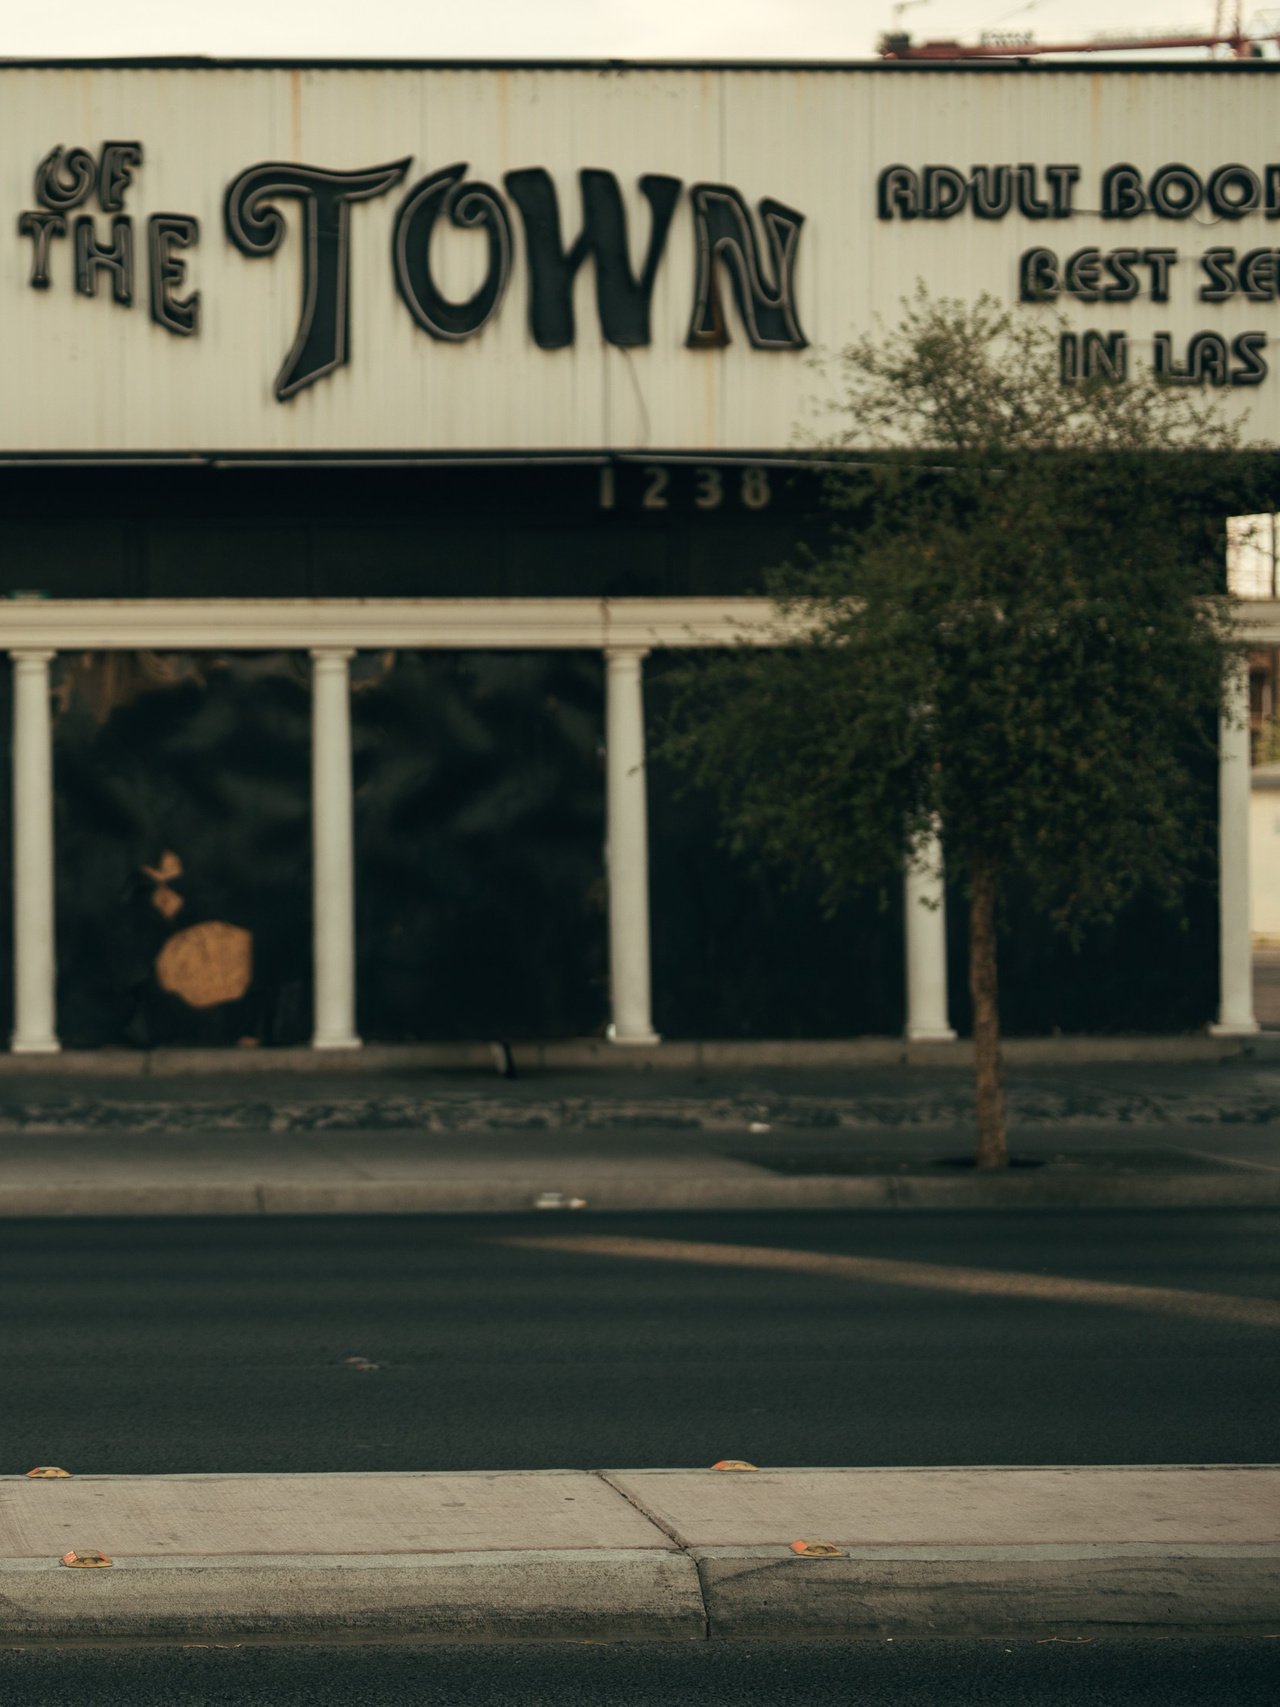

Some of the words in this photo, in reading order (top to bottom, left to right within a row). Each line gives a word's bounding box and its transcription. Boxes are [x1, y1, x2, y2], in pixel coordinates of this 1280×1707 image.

[35, 140, 144, 213] OF
[876, 162, 1081, 220] ADULT
[19, 211, 202, 337] THE
[223, 155, 810, 403] TOWN
[1020, 246, 1178, 302] BEST
[1200, 246, 1280, 302] SE
[1060, 329, 1127, 386] IN
[1154, 329, 1269, 386] LAS
[599, 467, 771, 508] 1238
